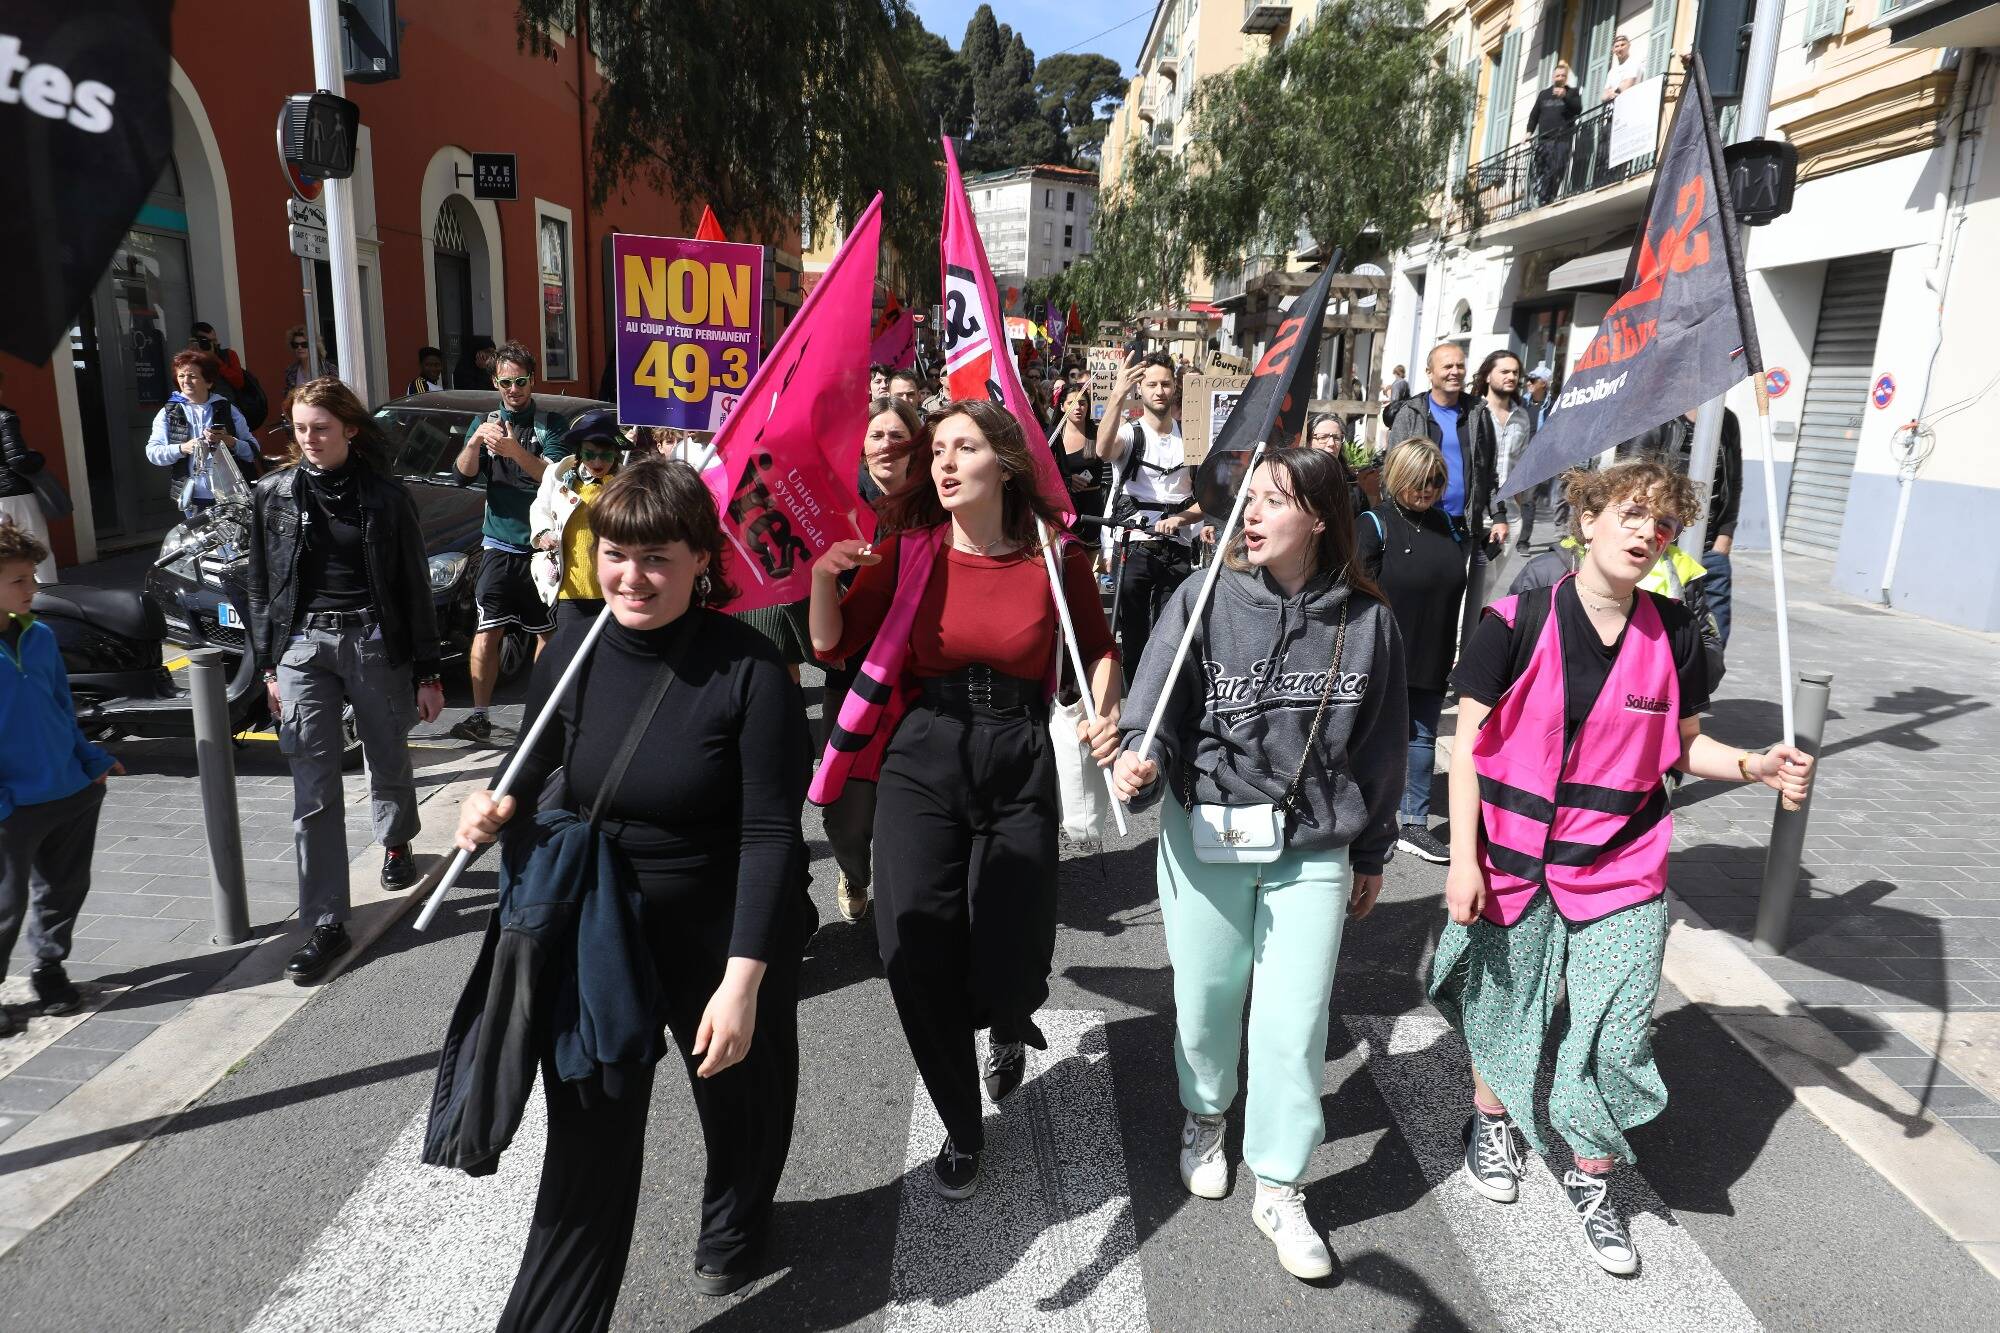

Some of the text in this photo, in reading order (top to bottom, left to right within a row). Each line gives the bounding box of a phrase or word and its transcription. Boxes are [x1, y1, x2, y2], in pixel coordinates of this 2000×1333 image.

[479, 165, 510, 176] EYE
[624, 254, 751, 328] NON
[625, 321, 752, 344] AU COUP D'ÉTAT PERMANENT
[634, 340, 749, 403] 49.3
[774, 480, 825, 548] syndicale
[787, 468, 822, 517] Union
